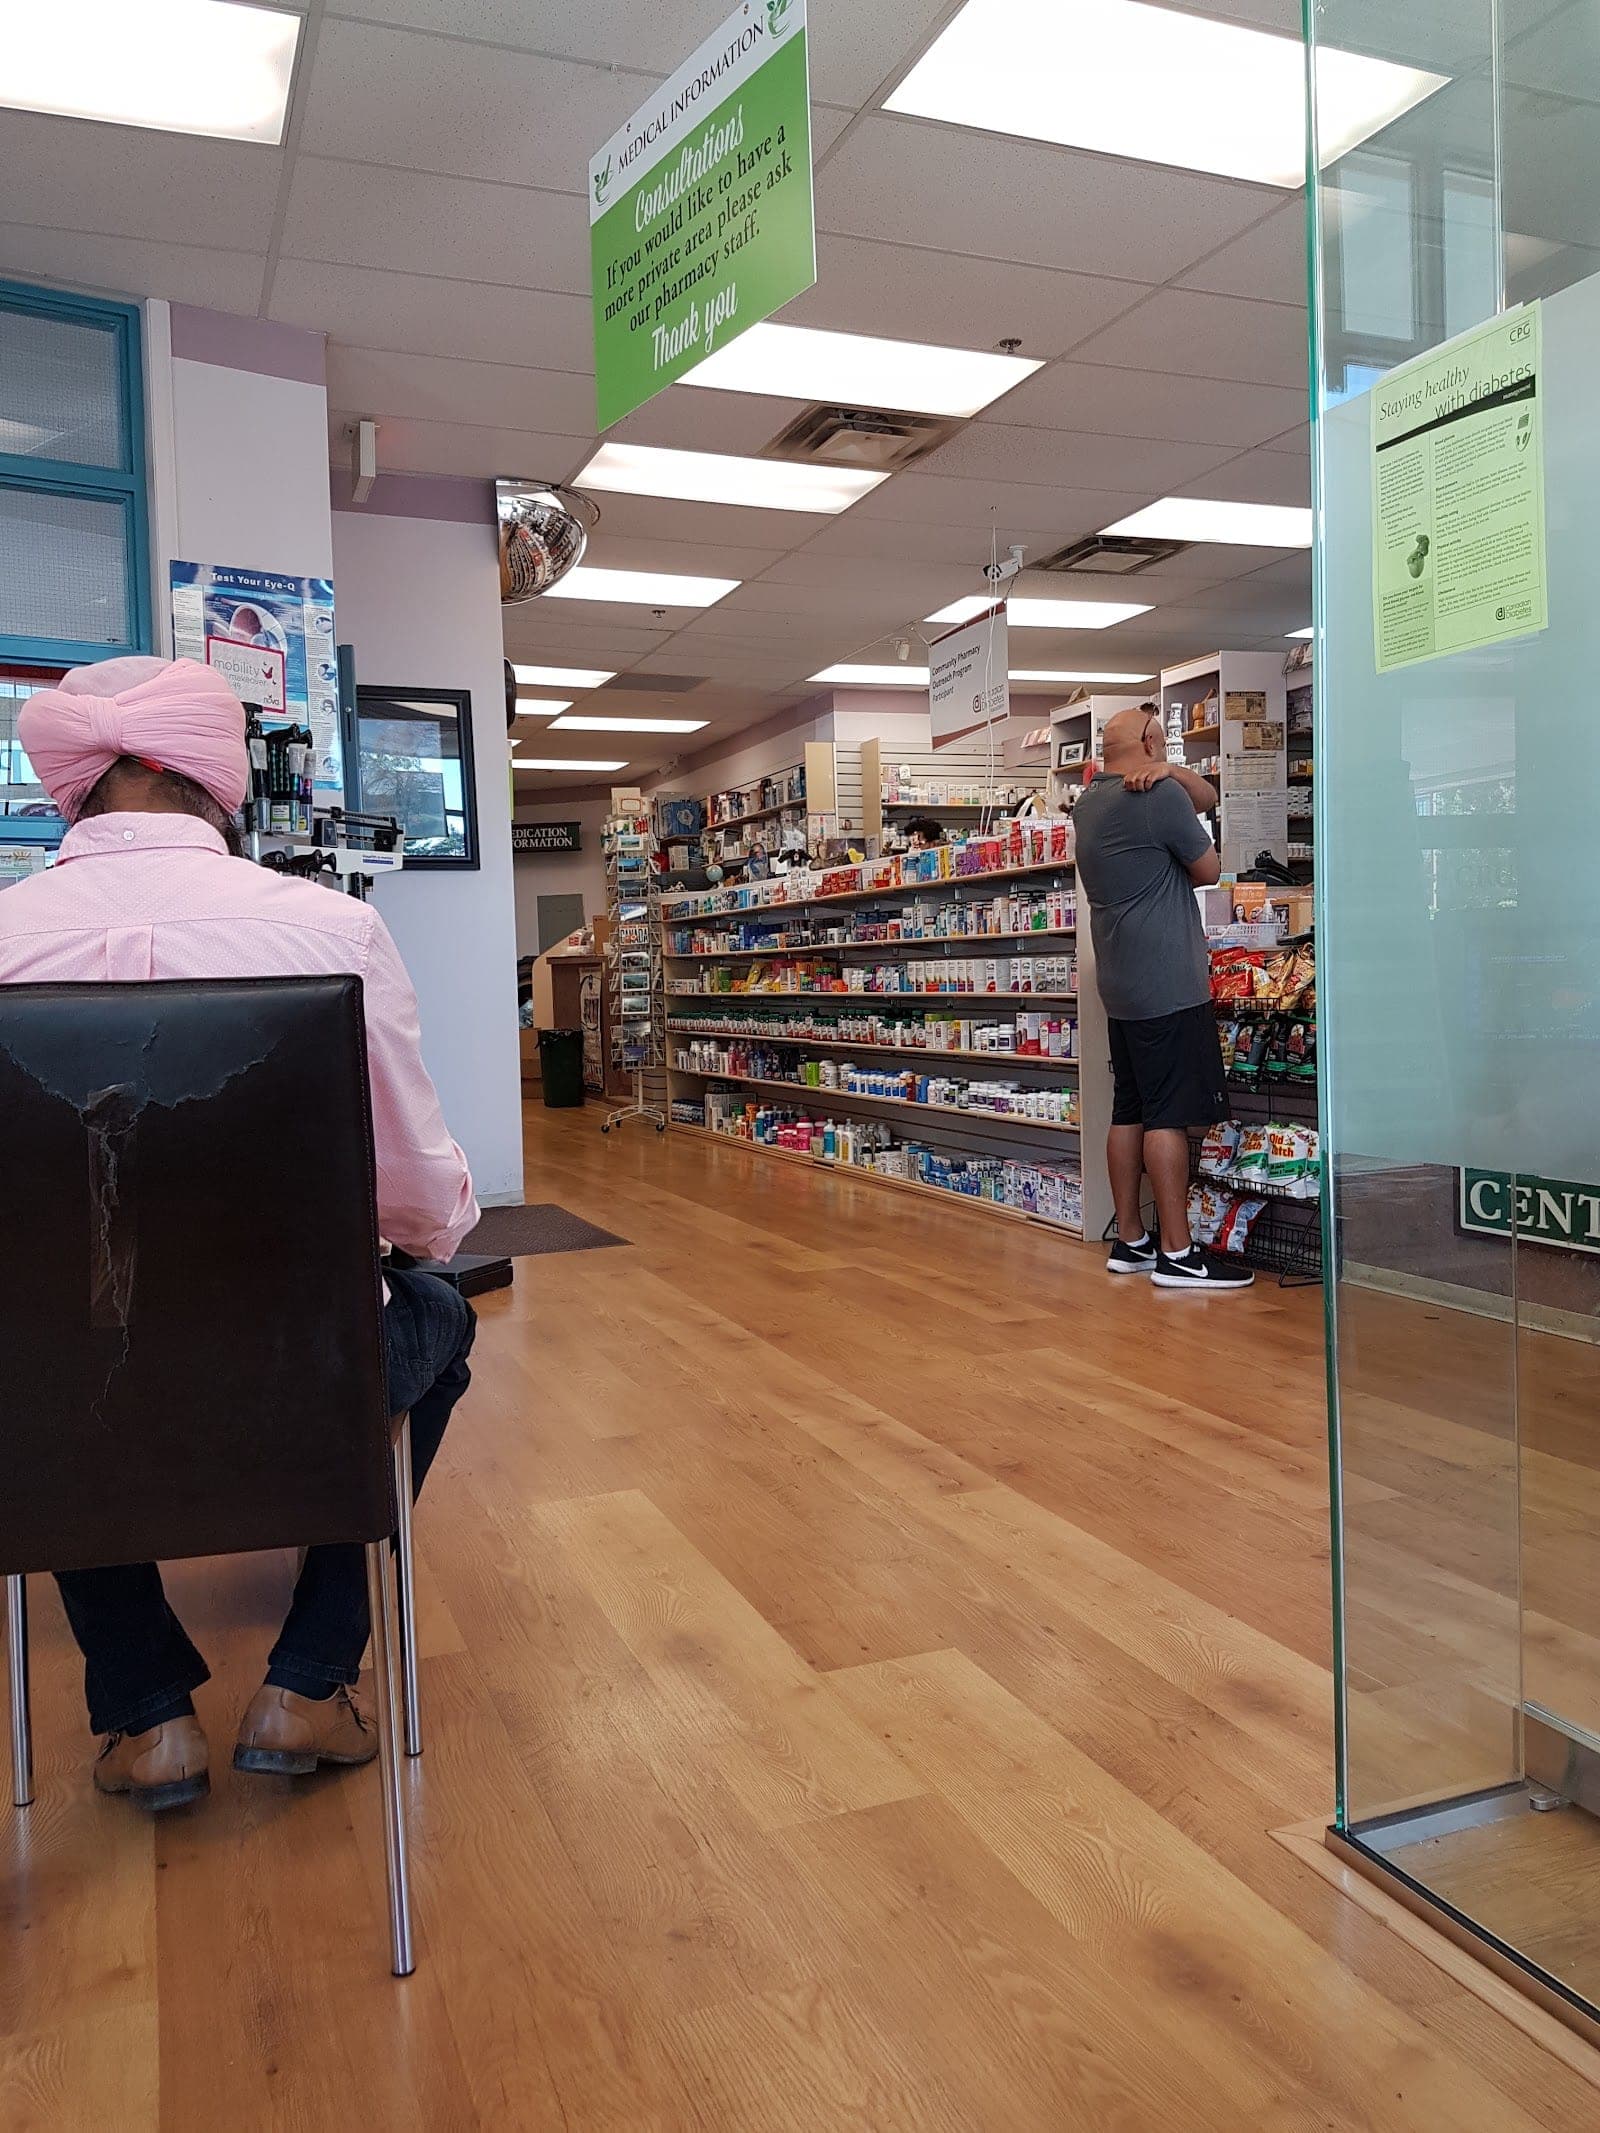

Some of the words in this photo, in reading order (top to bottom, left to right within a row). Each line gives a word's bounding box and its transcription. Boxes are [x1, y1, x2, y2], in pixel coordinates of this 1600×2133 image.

[618, 111, 669, 174] MEDICAL
[670, 15, 764, 124] INFORMATION
[635, 104, 744, 233] Consultations
[605, 286, 634, 322] more
[638, 247, 681, 302] private
[684, 221, 712, 257] area
[717, 181, 761, 238] please
[766, 149, 793, 190] ask
[607, 259, 618, 290] If
[619, 251, 641, 286] you
[644, 202, 683, 256] would
[687, 185, 713, 221] like
[718, 170, 732, 191] to
[737, 136, 772, 179] have
[777, 124, 786, 145] a
[630, 303, 651, 332] our
[654, 250, 719, 321] pharmacy
[723, 209, 760, 260] staff.
[651, 301, 701, 371] Thank
[704, 281, 739, 353] you
[1509, 322, 1531, 342] CPG
[1379, 388, 1423, 421] Staying
[1424, 365, 1470, 399] healthy
[1434, 389, 1465, 419] with
[1468, 362, 1532, 402] diabetes
[211, 572, 235, 583] Test
[237, 575, 261, 586] Your
[264, 579, 296, 592] Eye-Q
[213, 659, 260, 677] mobility
[512, 836, 573, 849] ORMATION
[1269, 1133, 1284, 1145] Old
